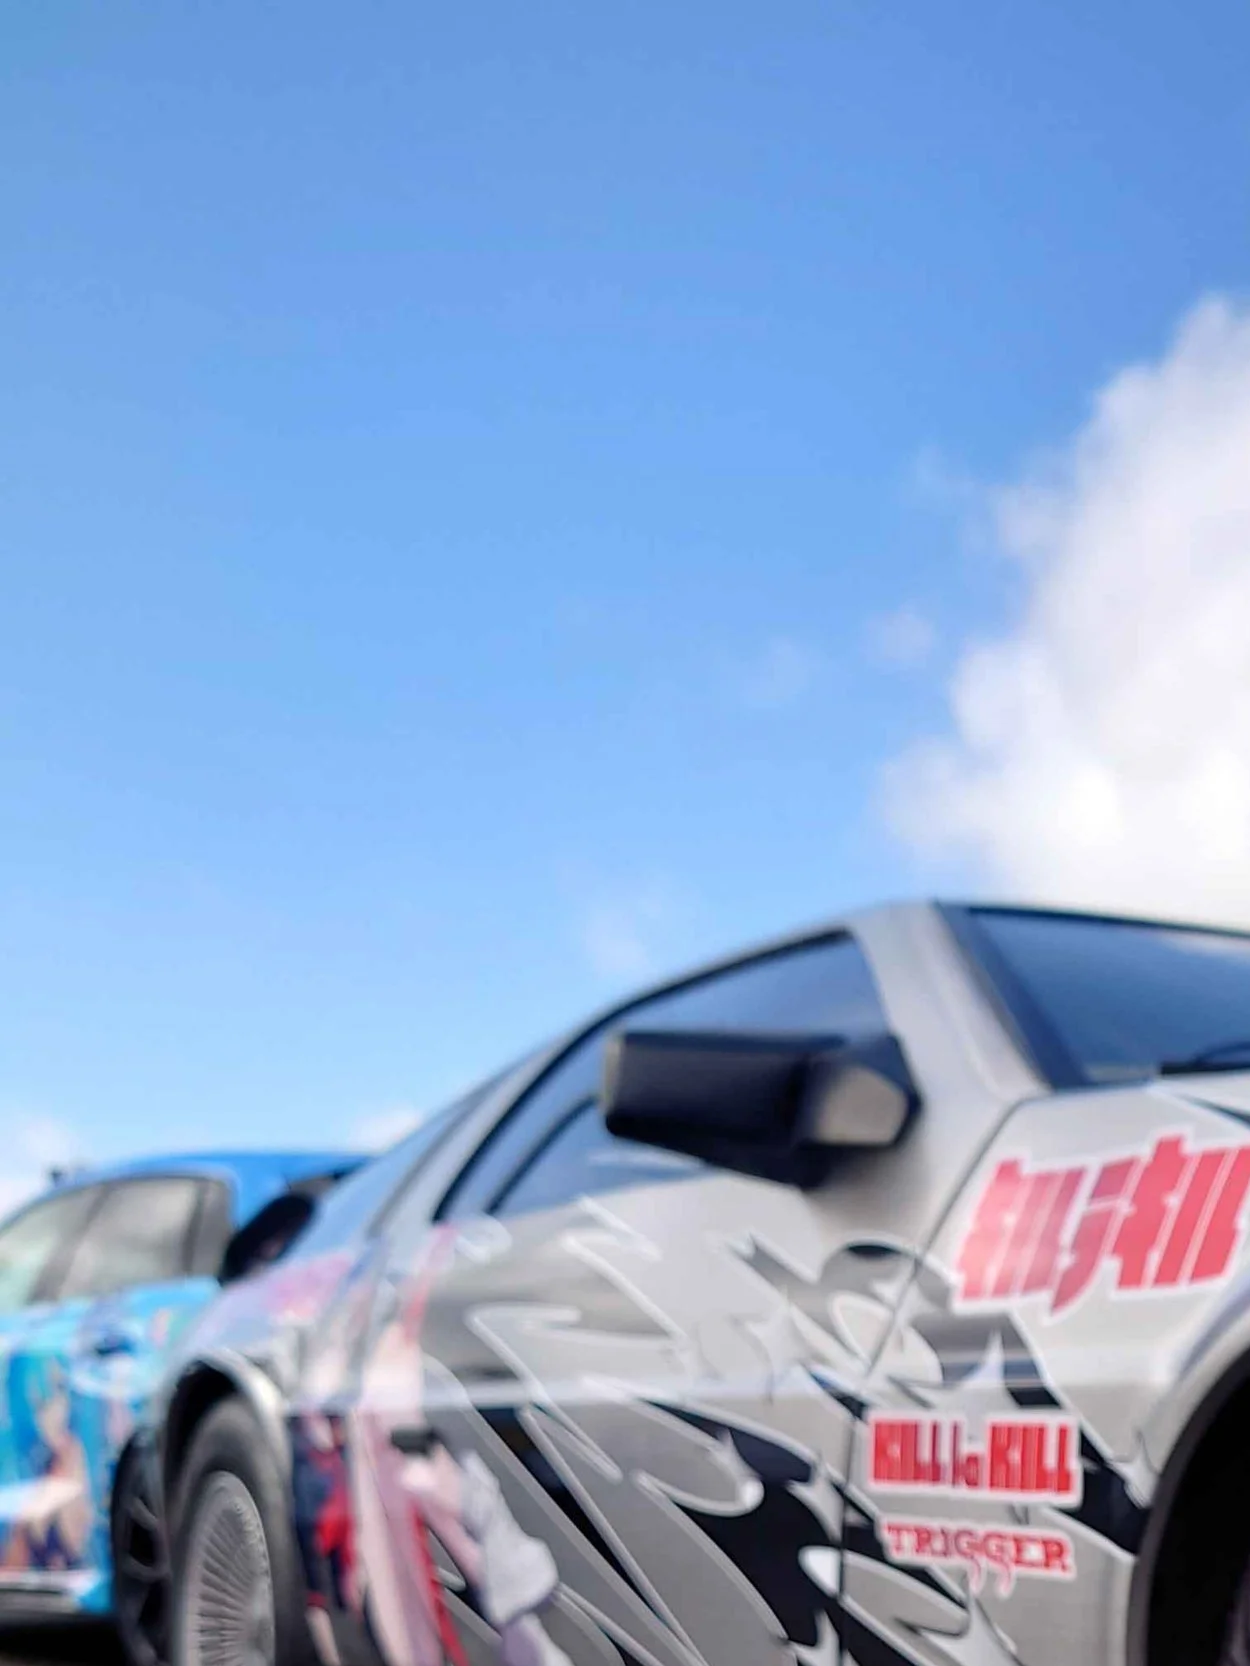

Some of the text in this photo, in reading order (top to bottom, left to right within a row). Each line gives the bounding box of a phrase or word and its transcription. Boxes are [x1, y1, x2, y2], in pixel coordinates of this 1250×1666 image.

[872, 1420, 942, 1483] KILL
[989, 1424, 1073, 1493] KILL
[885, 1524, 1070, 1596] TRIGGER
